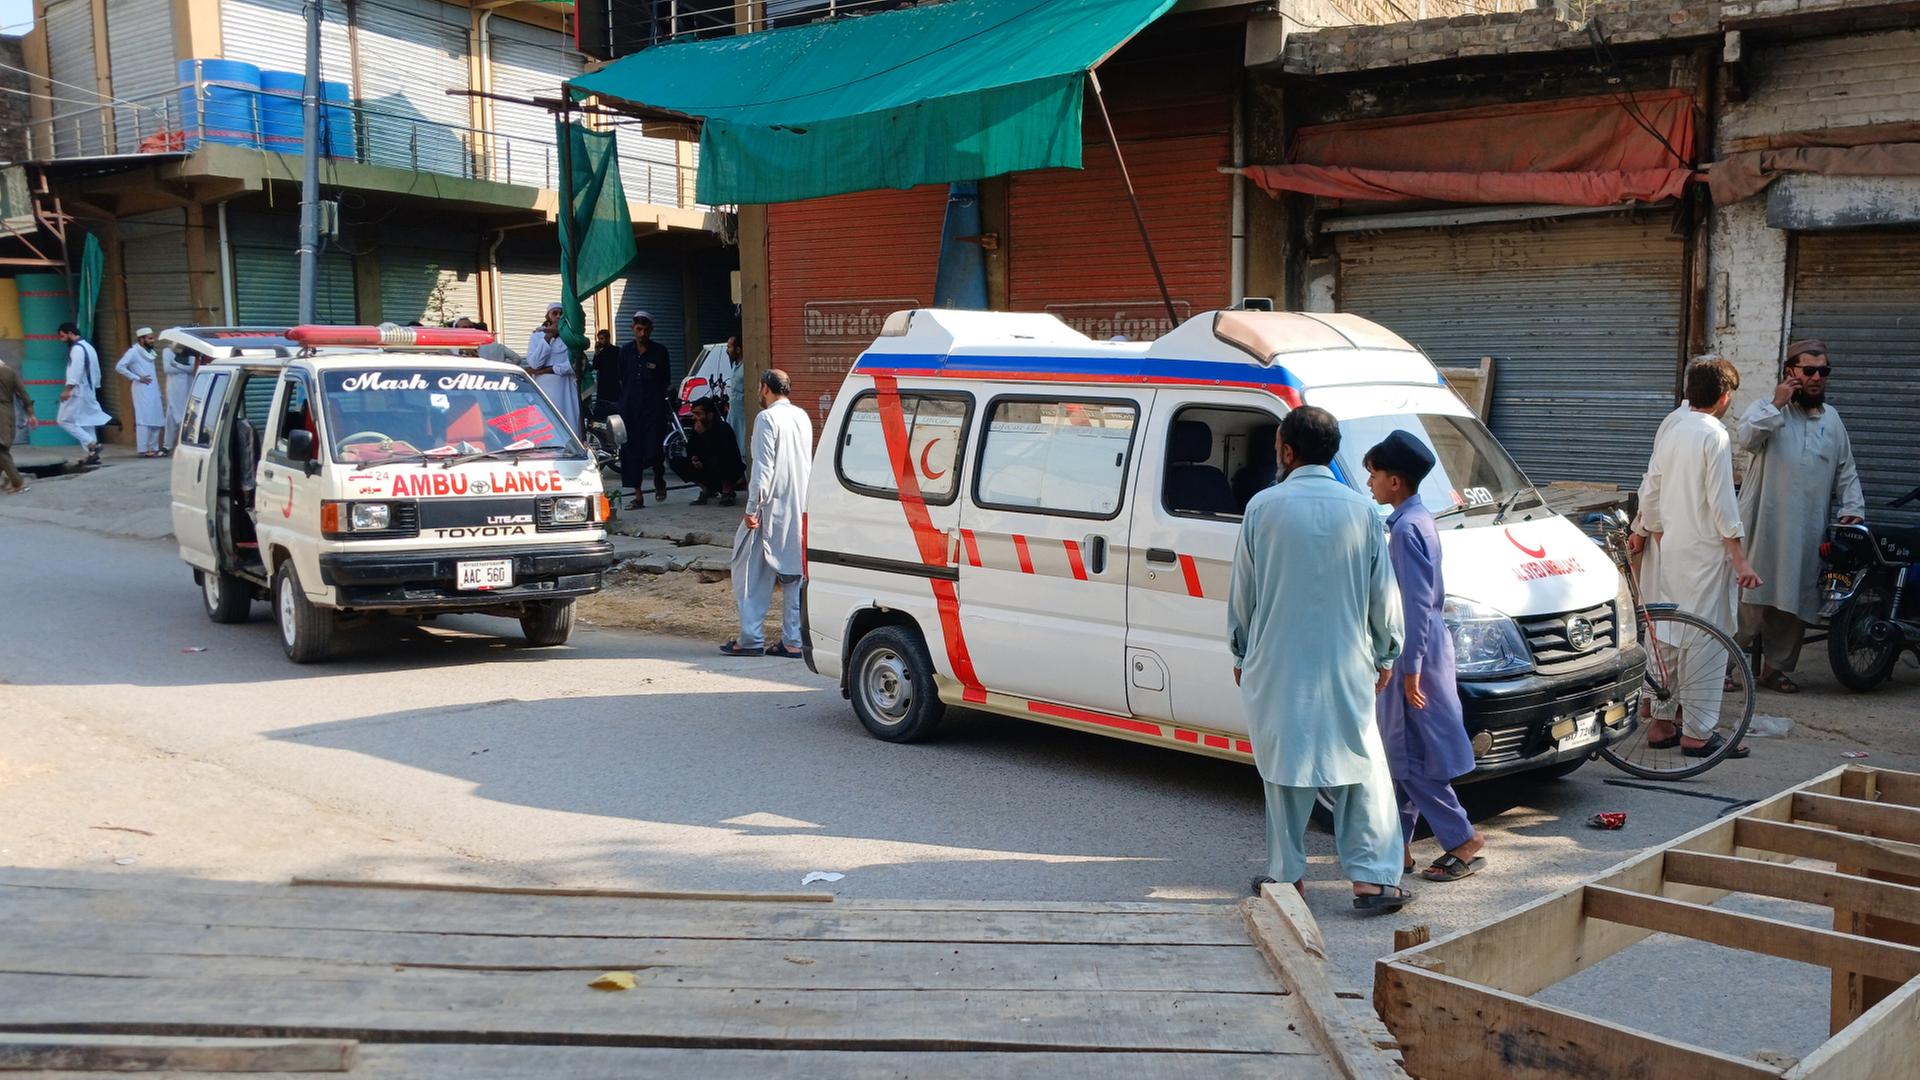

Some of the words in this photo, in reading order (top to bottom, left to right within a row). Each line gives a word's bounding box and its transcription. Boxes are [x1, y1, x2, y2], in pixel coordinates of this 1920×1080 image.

[808, 309, 886, 335] Durafo
[809, 357, 845, 372] PRICE
[342, 372, 429, 391] Mash
[438, 373, 519, 391] Allah
[377, 471, 391, 481] 24
[392, 473, 467, 496] AMBU
[490, 470, 562, 493] LANCE
[1464, 487, 1494, 504] SYED
[435, 526, 526, 539] TOYOTA
[463, 569, 482, 584] AAC
[487, 567, 505, 582] 560
